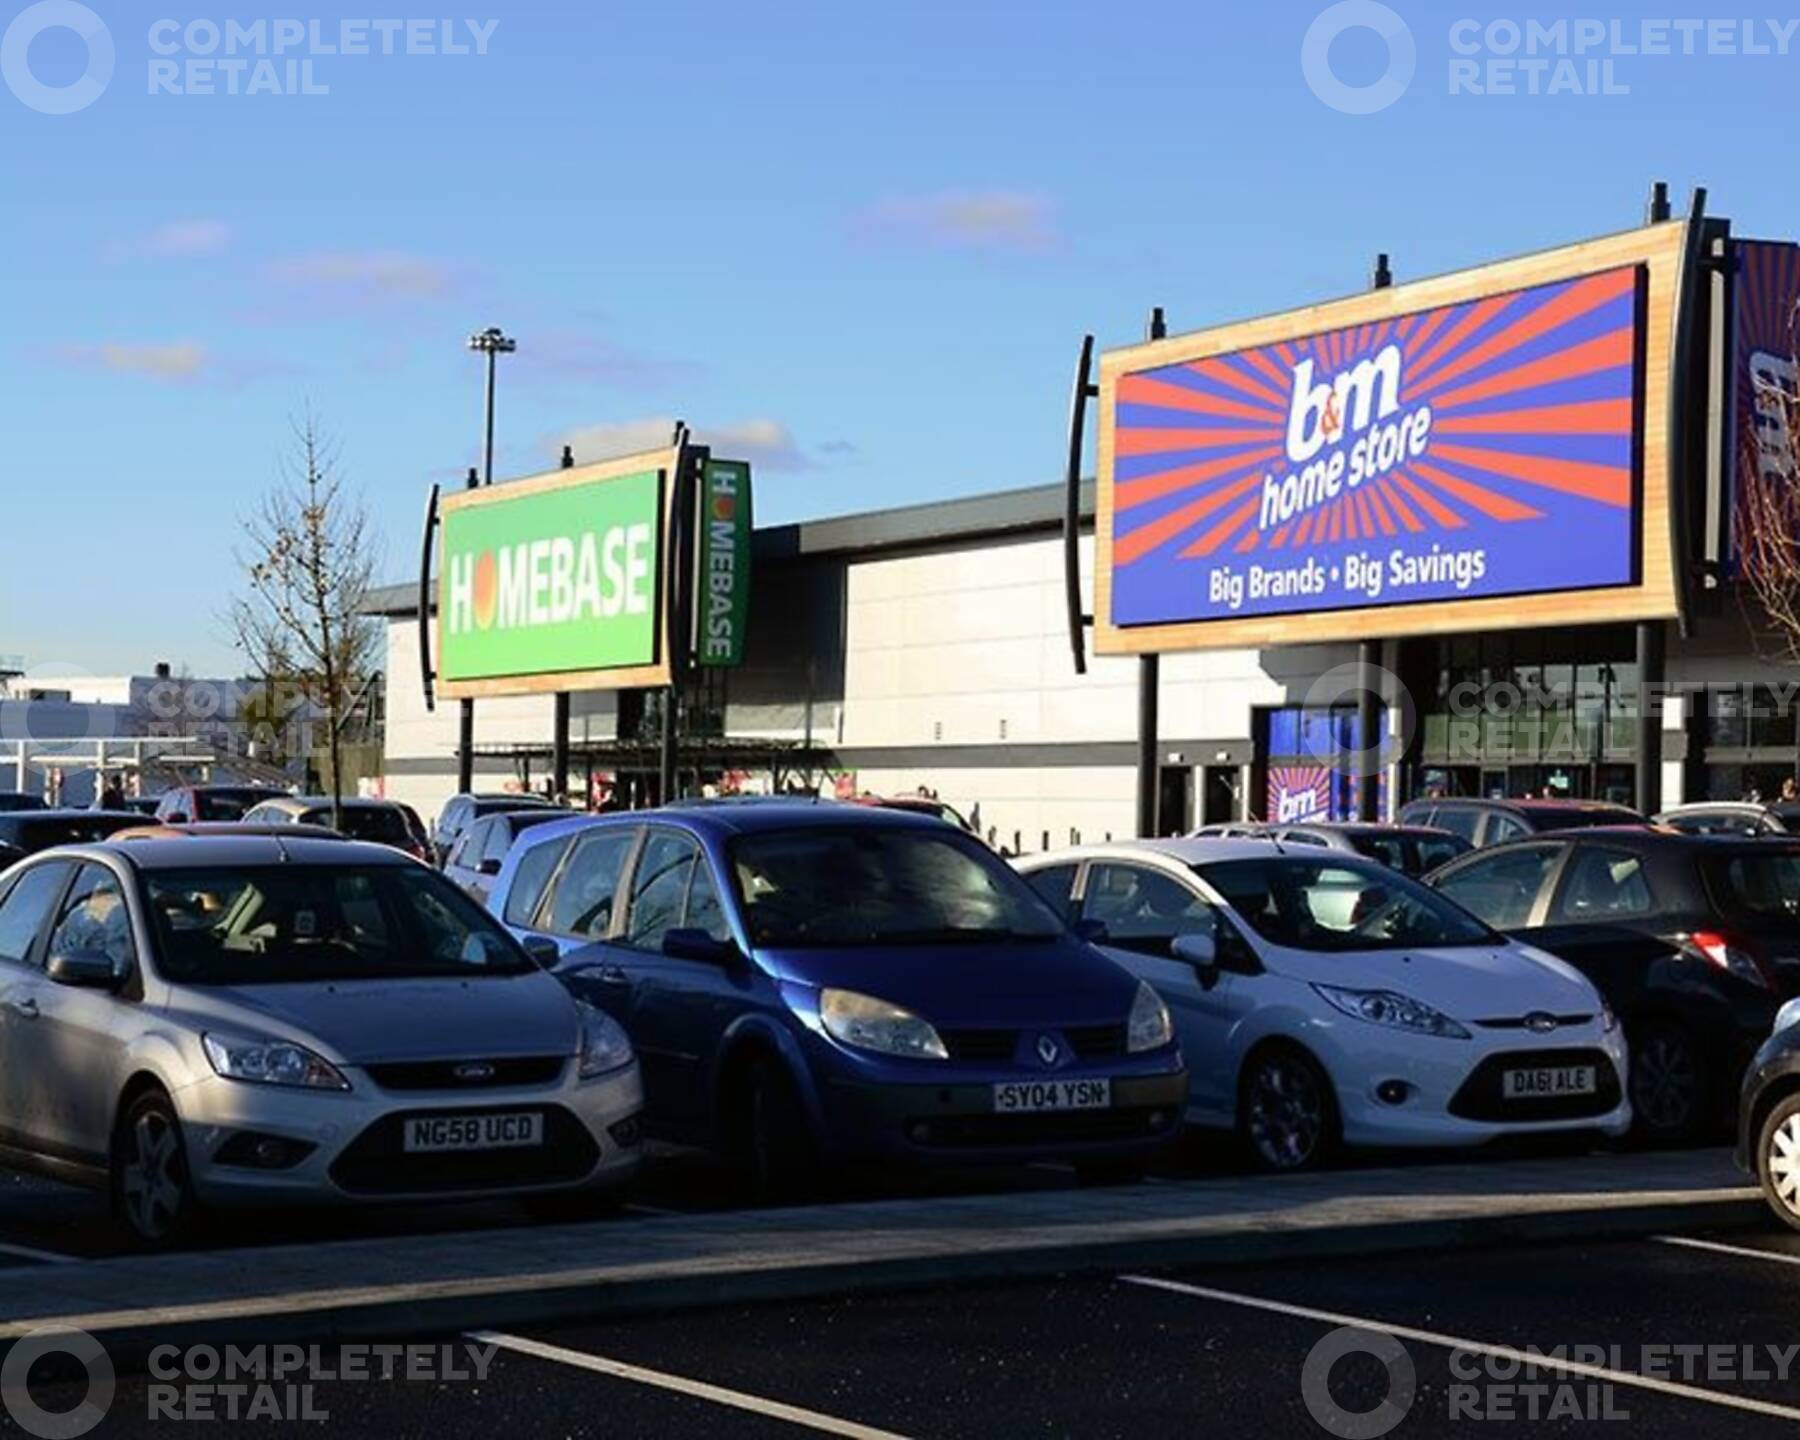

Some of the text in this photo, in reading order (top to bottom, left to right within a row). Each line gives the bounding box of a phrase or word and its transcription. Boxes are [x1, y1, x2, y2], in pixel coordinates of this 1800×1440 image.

[1287, 345, 1400, 461] b&m
[1260, 407, 1432, 530] home store
[450, 523, 649, 634] HOMEBASE
[707, 469, 737, 657] HOMEBASE
[1209, 567, 1243, 609] Big
[1250, 558, 1325, 598] Brands
[1344, 553, 1383, 597] Big
[1389, 544, 1486, 588] Savings
[414, 1115, 532, 1145] NG58 UCD
[1003, 1085, 1058, 1107] SY04
